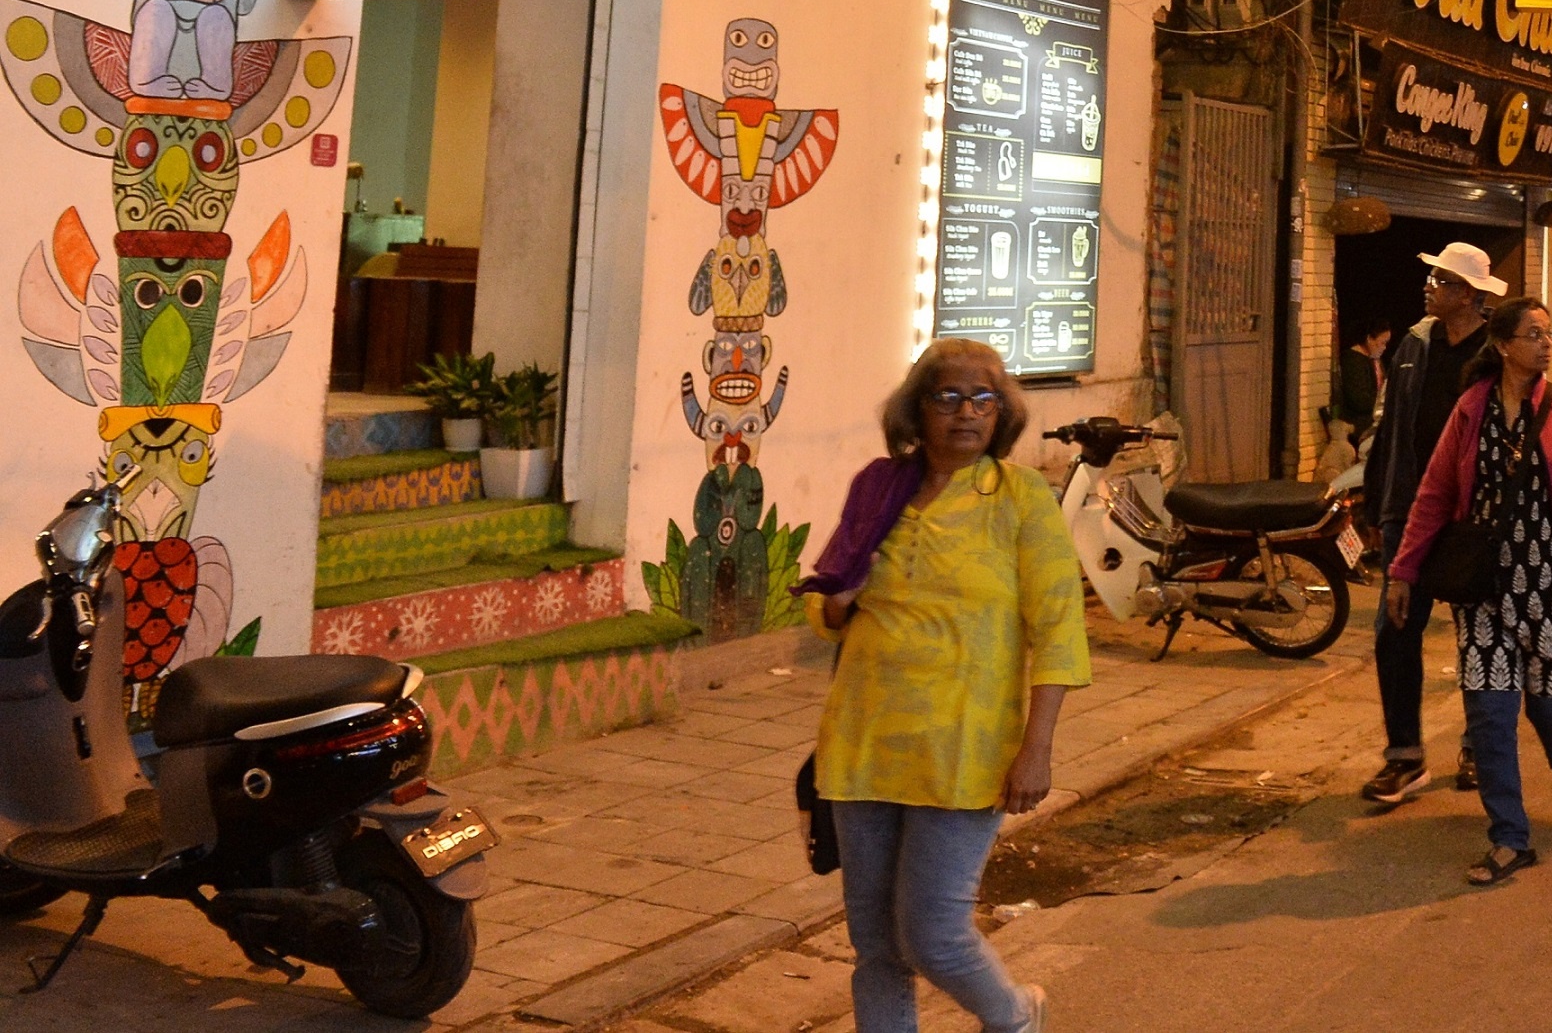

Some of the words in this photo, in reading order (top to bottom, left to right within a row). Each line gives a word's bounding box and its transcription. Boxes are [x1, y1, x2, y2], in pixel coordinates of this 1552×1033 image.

[1061, 46, 1083, 58] JUICE
[1396, 64, 1454, 134] Congee
[1450, 81, 1489, 146] King
[976, 123, 994, 133] TEA
[963, 203, 999, 215] YOGURT
[1045, 205, 1086, 215] SMOOTHIES
[959, 317, 994, 327] OTHERS
